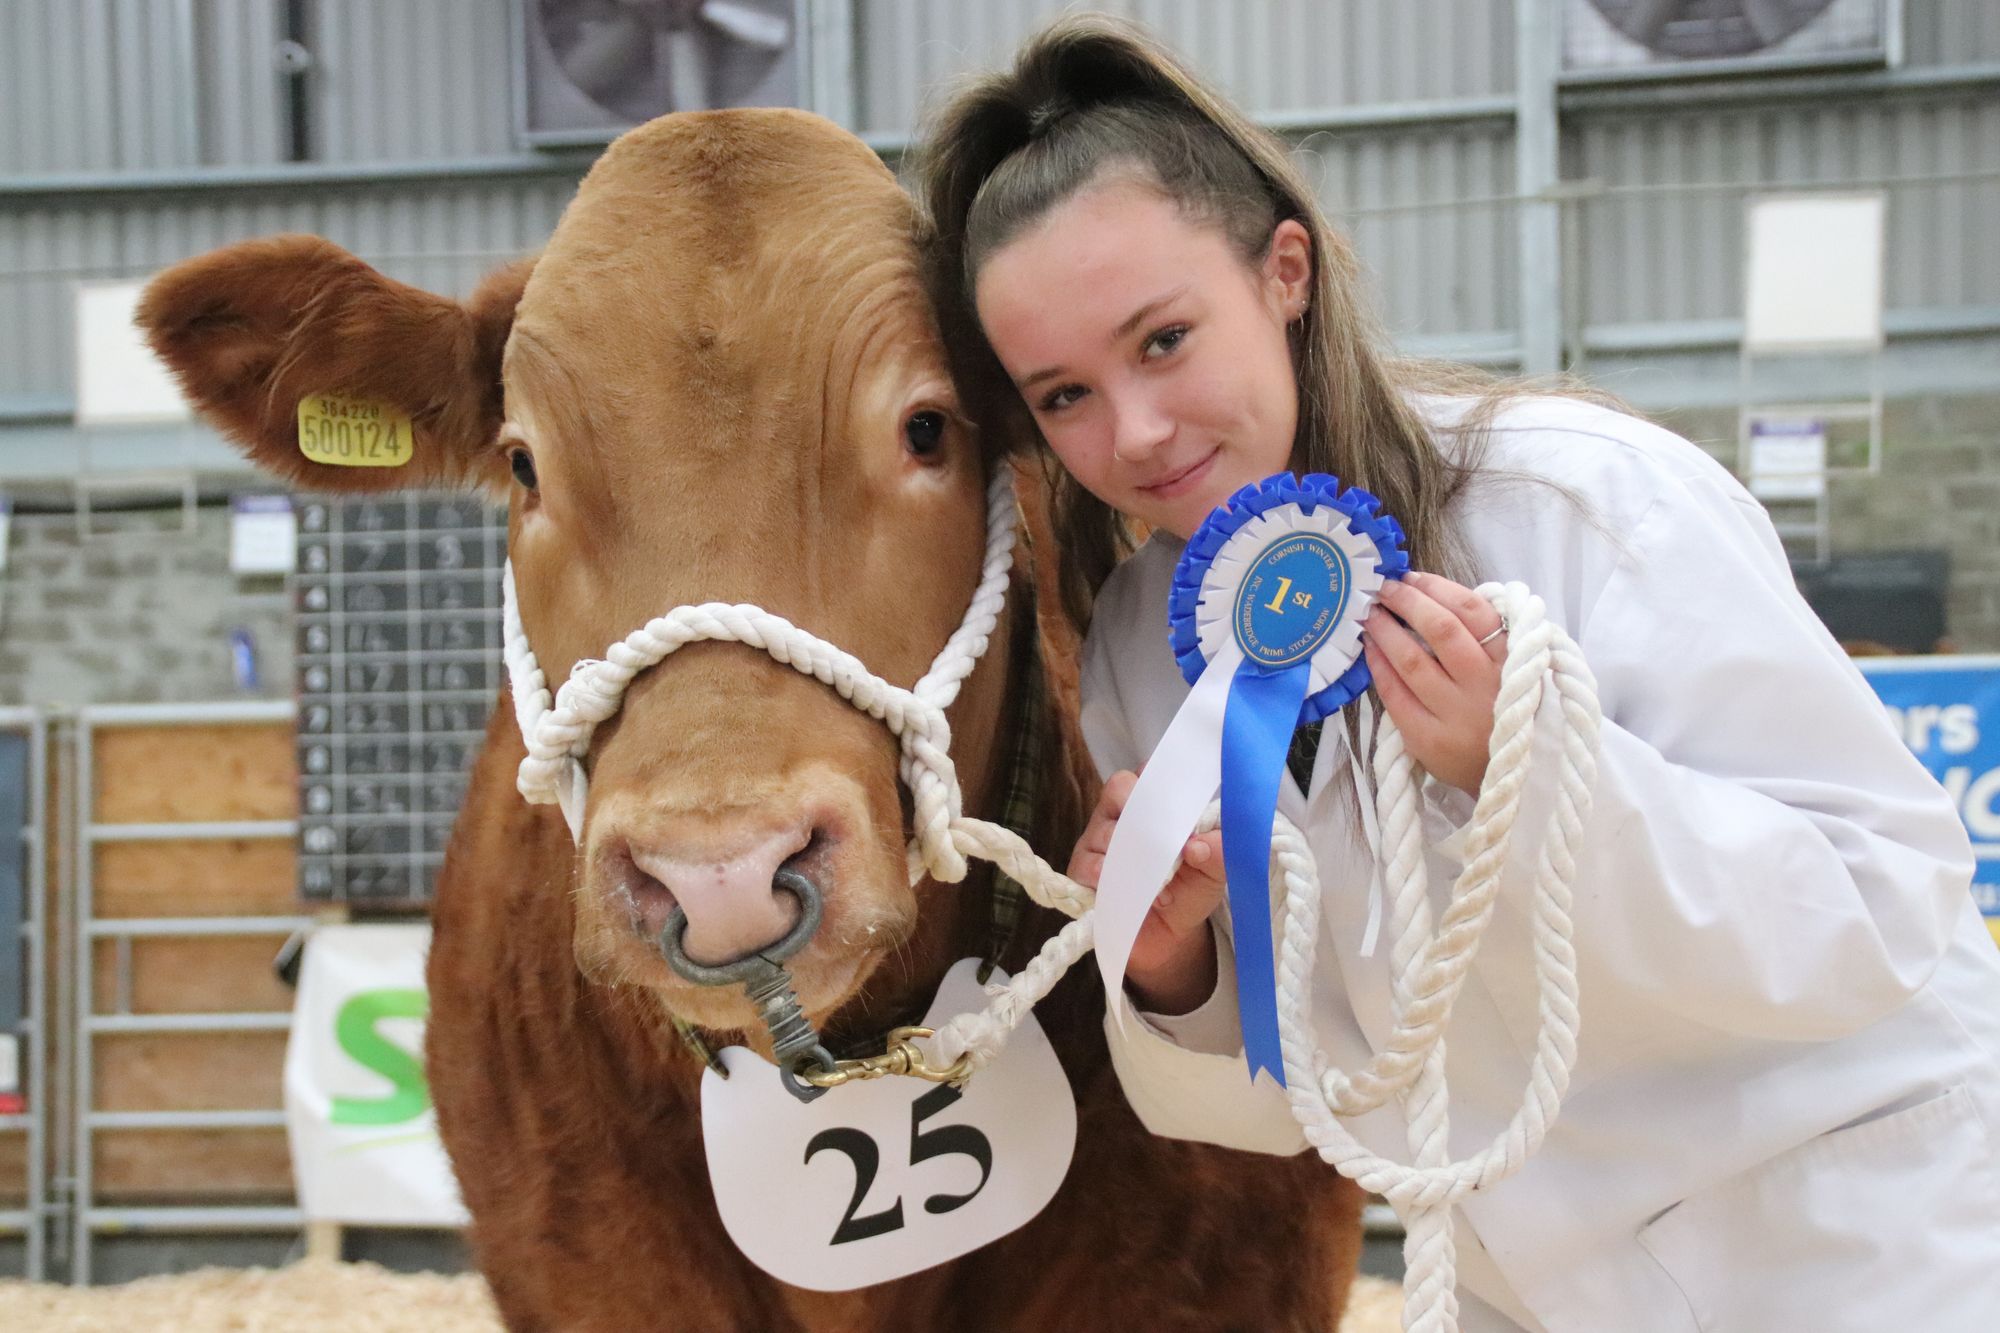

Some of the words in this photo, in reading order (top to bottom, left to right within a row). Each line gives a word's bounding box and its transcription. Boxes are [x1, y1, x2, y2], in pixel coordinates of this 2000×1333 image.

[304, 414, 401, 458] 500124
[1267, 543, 1304, 565] CORNISH
[1309, 543, 1335, 569] WINTER
[1329, 572, 1338, 592] FAIR
[1243, 593, 1260, 648] WADEBRIDGE
[1259, 645, 1285, 656] PRIME
[1288, 632, 1315, 653] STOCK
[1312, 607, 1330, 631] SHOW
[803, 1083, 993, 1246] 25
